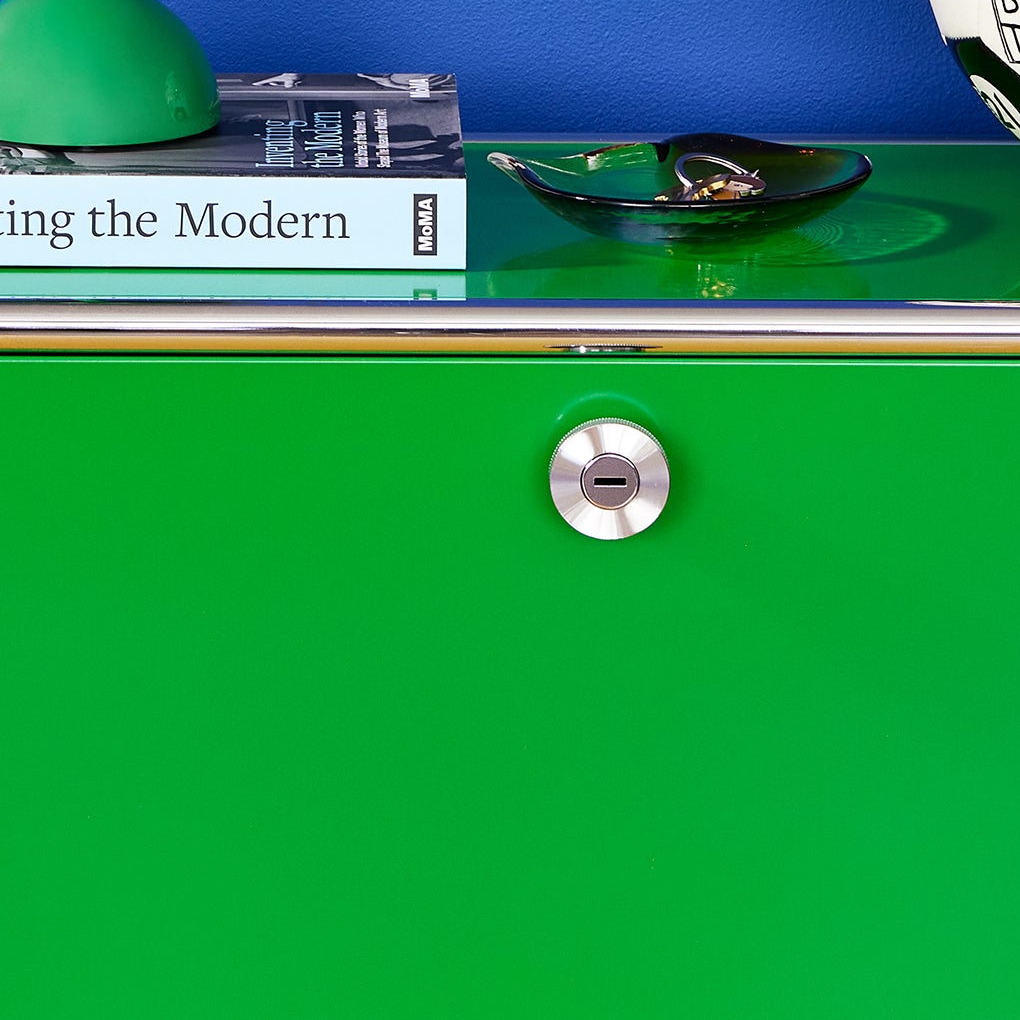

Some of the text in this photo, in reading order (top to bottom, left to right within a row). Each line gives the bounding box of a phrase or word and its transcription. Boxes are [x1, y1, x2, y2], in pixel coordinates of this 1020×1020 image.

[254, 119, 308, 168] Inventing
[301, 111, 344, 168] the Modern
[87, 198, 157, 238] the
[175, 200, 350, 239] Modern
[416, 197, 434, 252] MoMA
